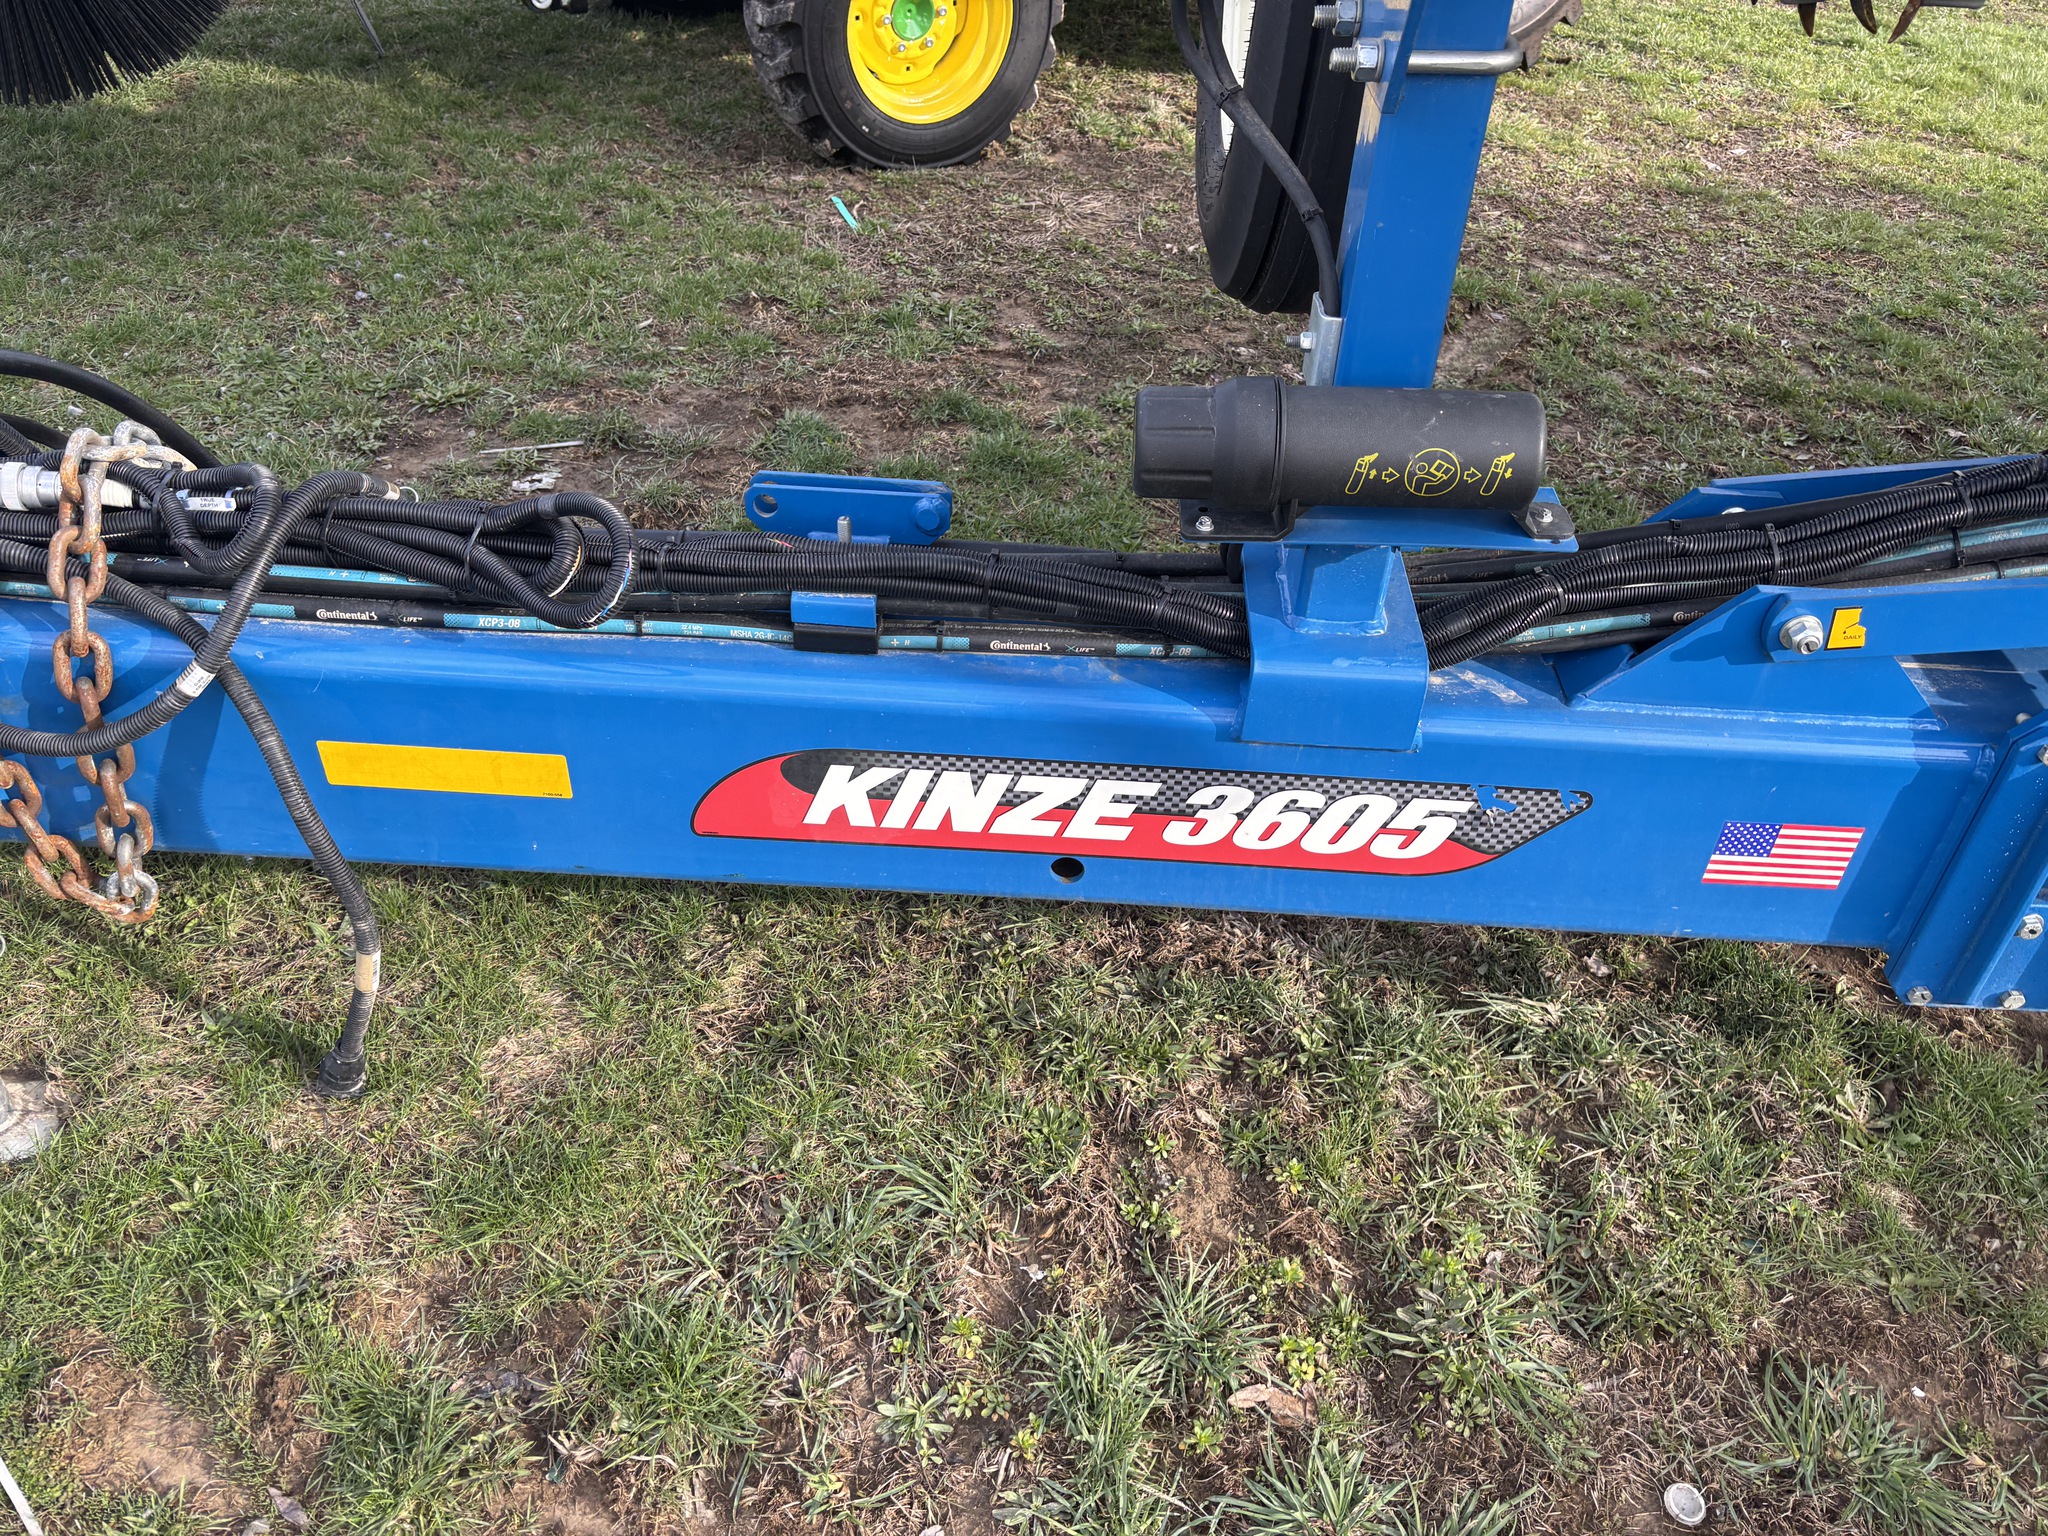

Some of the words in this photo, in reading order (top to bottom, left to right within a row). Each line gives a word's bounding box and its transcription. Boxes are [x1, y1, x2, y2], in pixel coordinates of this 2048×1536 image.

[316, 609, 371, 621] Continental
[478, 617, 521, 628] XCP3-08
[730, 629, 753, 638] MSHA
[990, 640, 1043, 651] Continental
[801, 763, 1163, 842] KINZE
[1161, 785, 1475, 860] 3605
